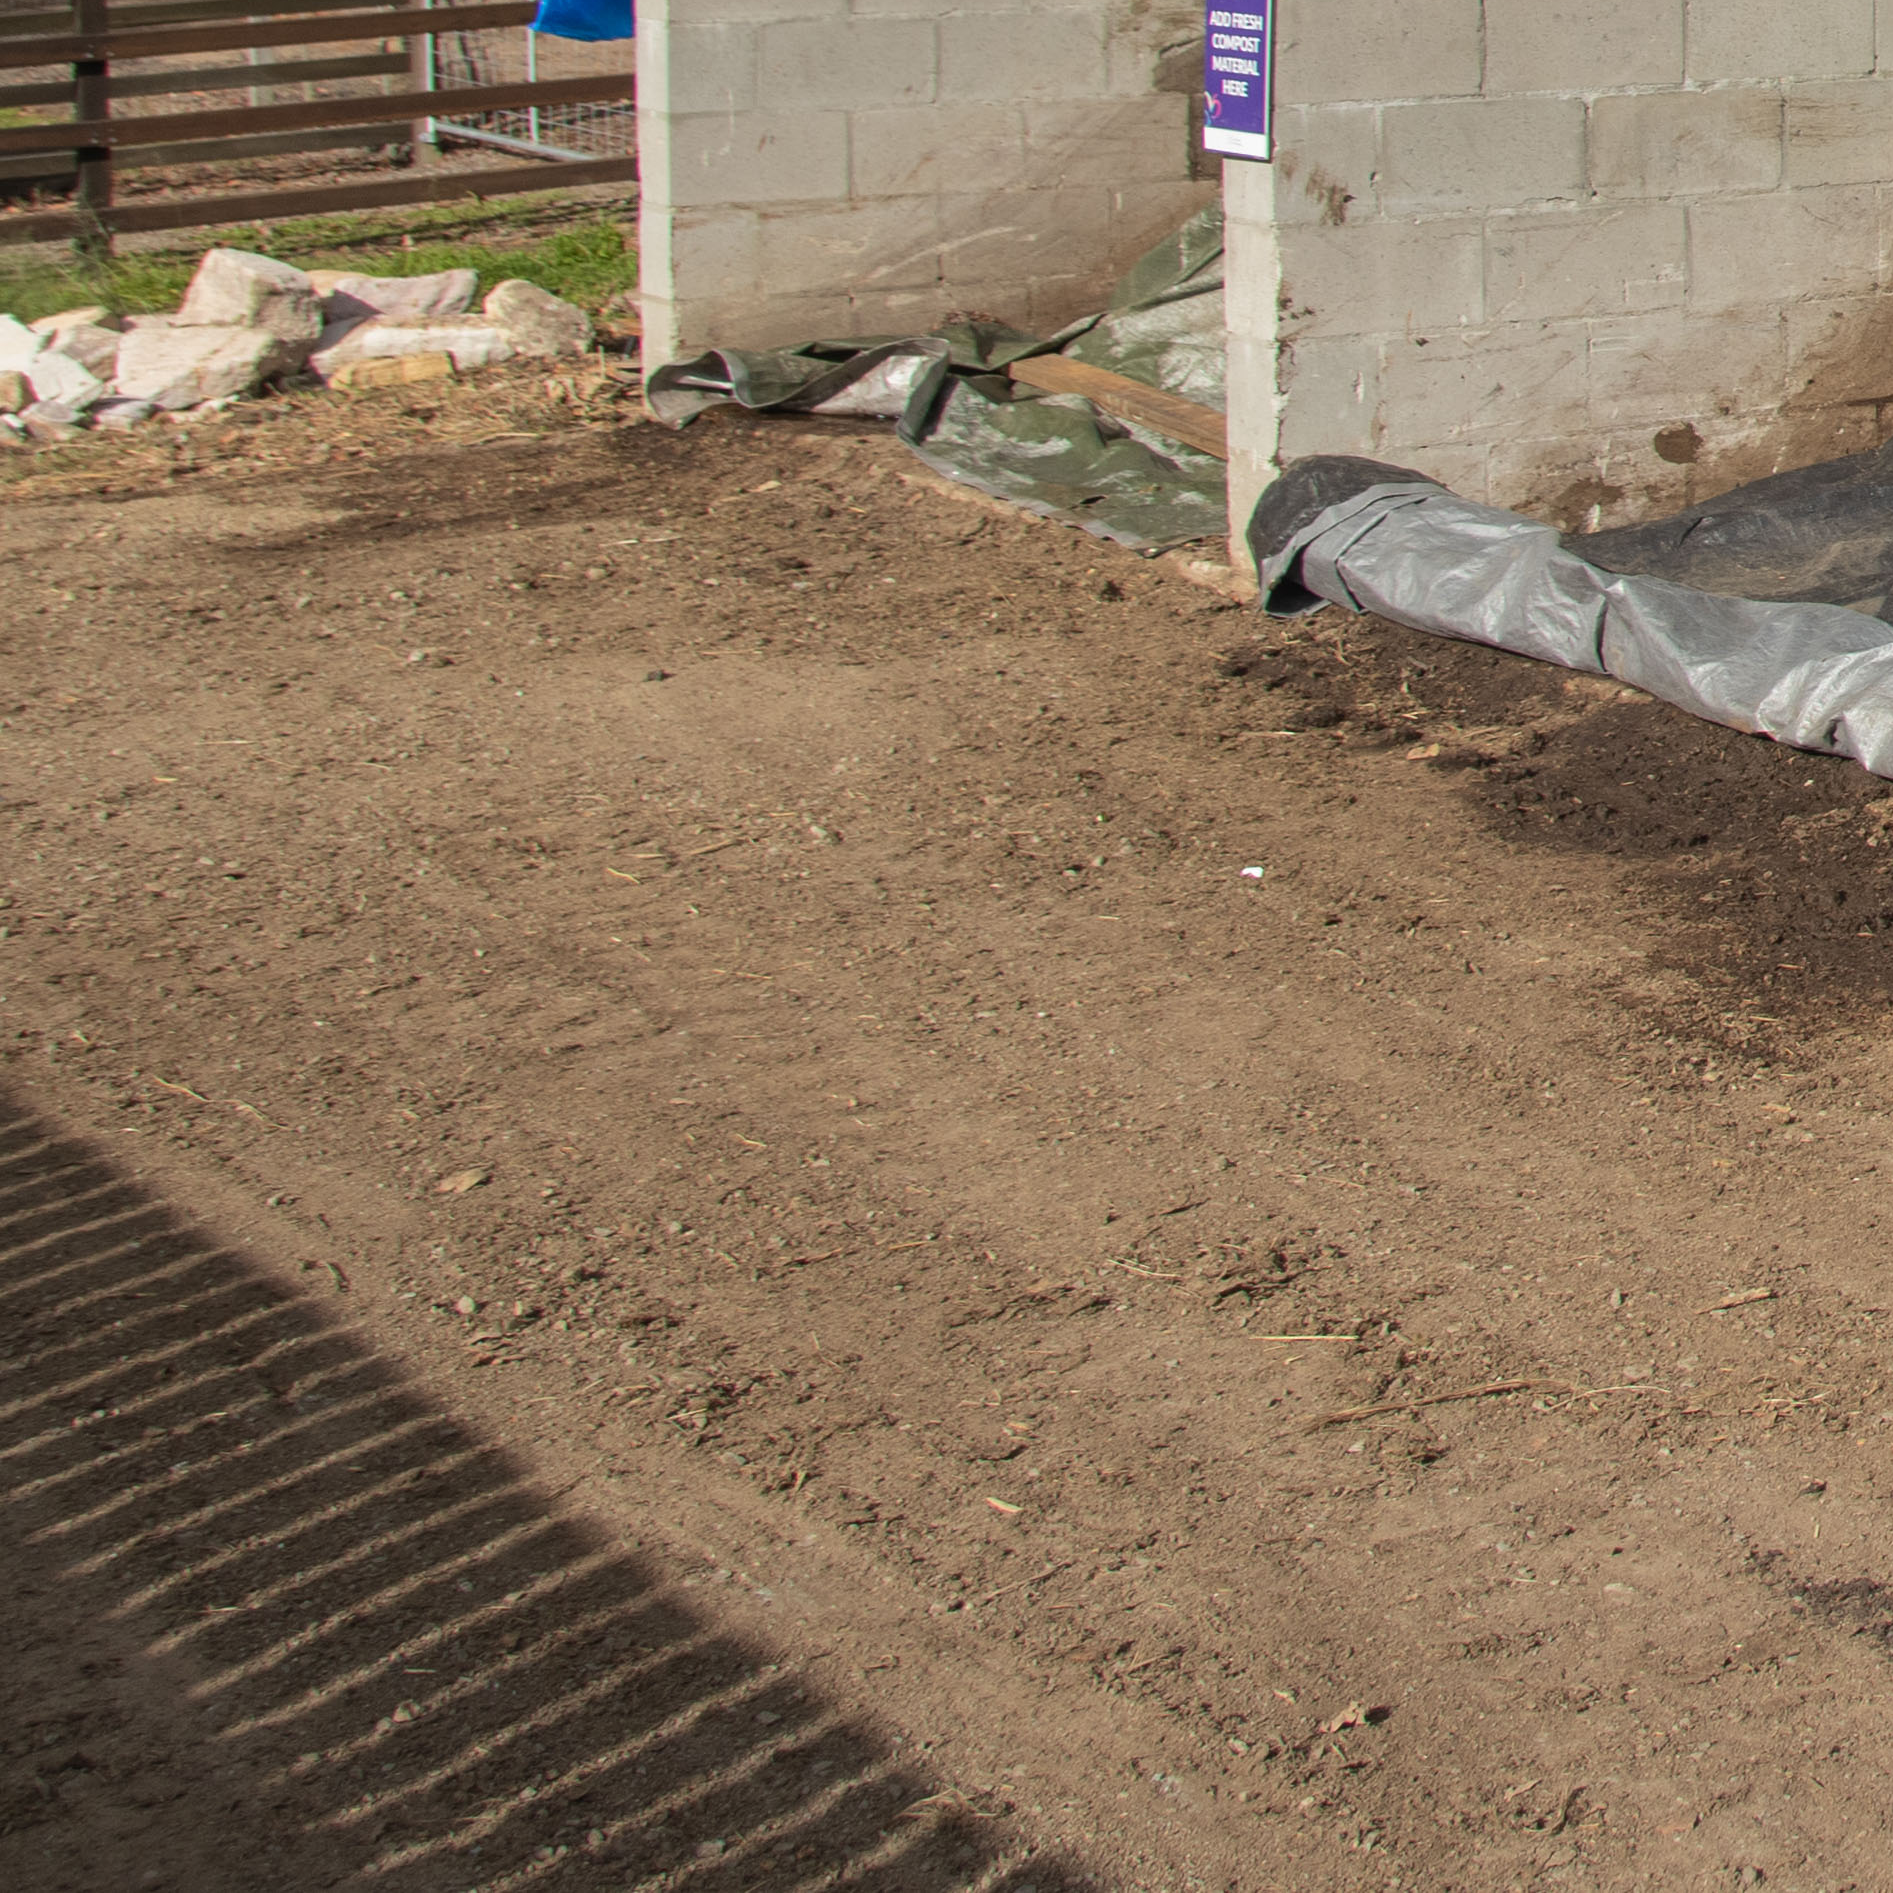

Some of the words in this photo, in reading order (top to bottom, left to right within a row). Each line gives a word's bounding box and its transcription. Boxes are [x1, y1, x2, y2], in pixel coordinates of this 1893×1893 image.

[1210, 11, 1230, 27] ADD
[1233, 13, 1263, 31] FRESH
[1212, 33, 1260, 52] COMPOST
[1212, 55, 1259, 75] MATERIAL
[1222, 79, 1248, 97] HERE
